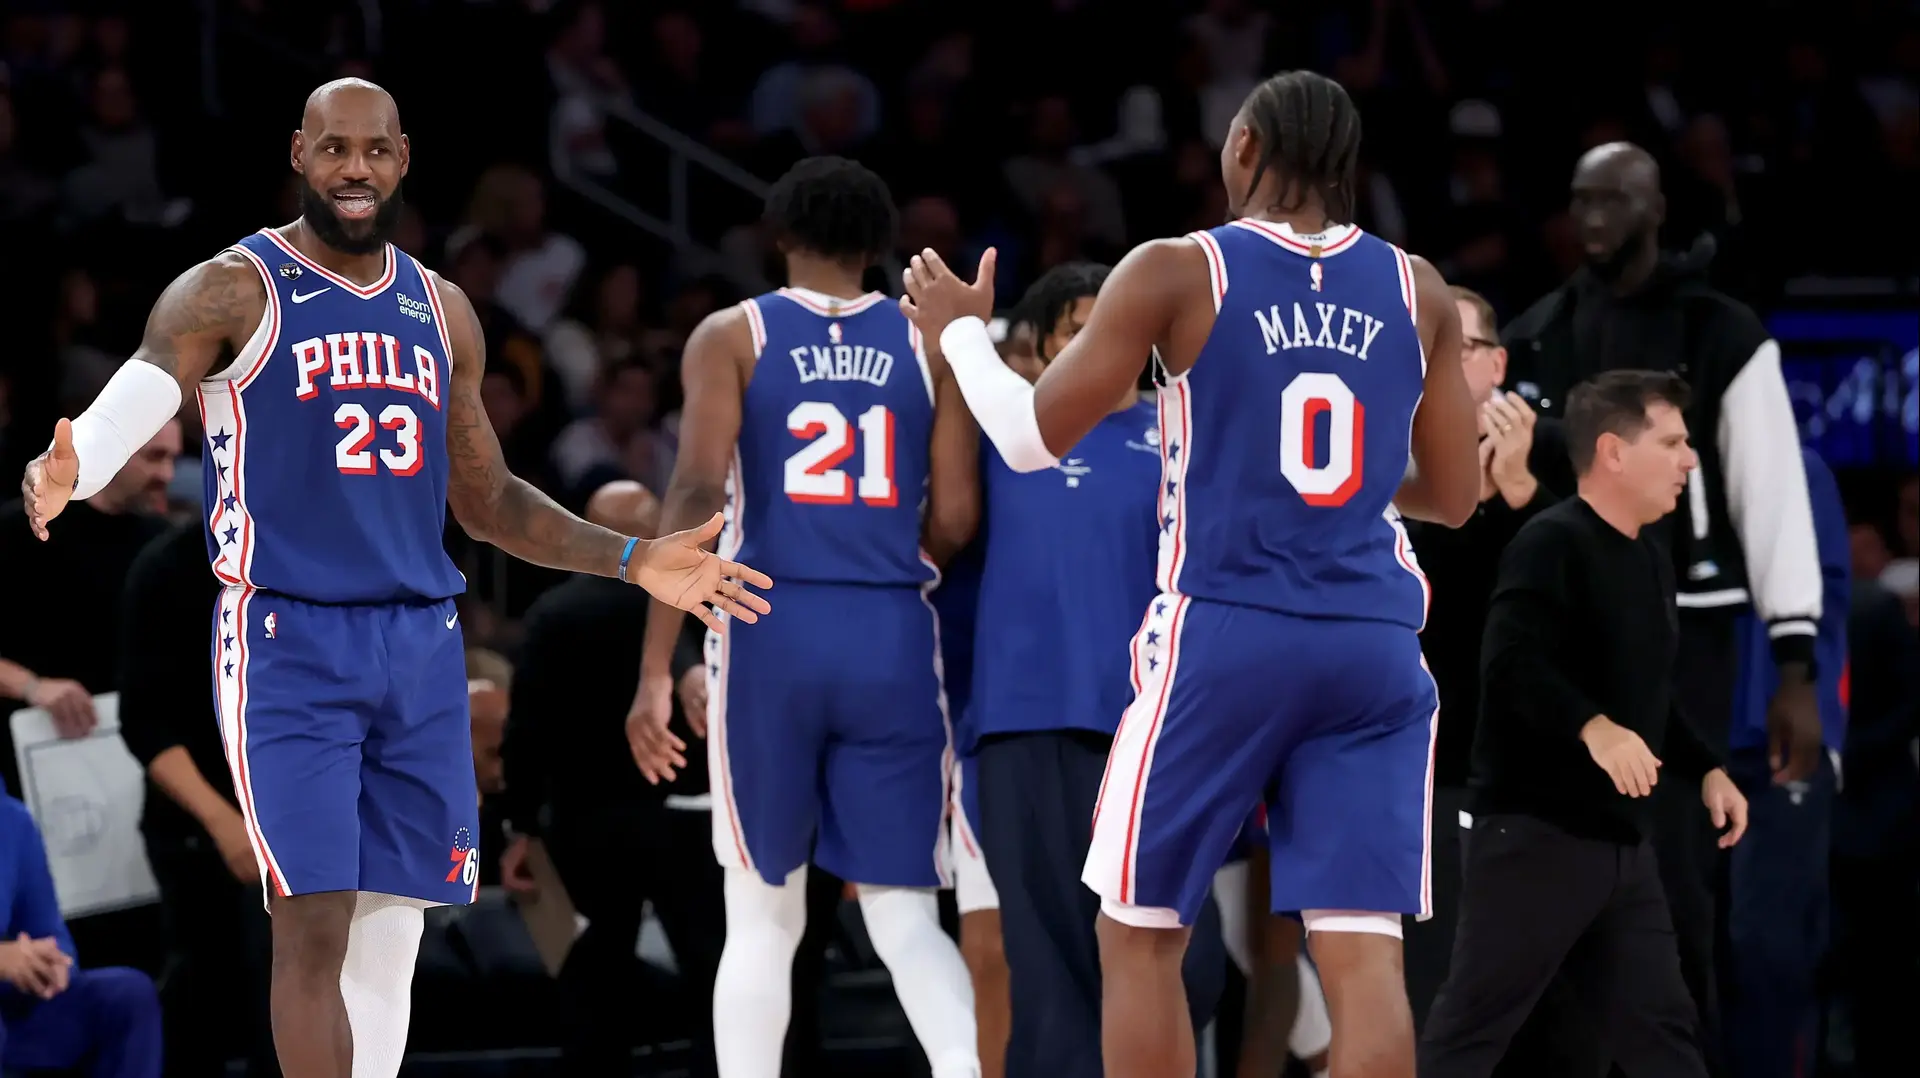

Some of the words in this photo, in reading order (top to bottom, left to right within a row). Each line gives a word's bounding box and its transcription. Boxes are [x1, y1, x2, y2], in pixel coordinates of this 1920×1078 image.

[396, 292, 431, 313] Bloom
[399, 305, 431, 324] energy
[1254, 302, 1384, 361] MAXEY
[291, 331, 440, 411] PHILA
[789, 345, 894, 387] EMBIID
[333, 403, 424, 476] 23
[784, 401, 898, 507] 21
[1280, 372, 1365, 507] 0
